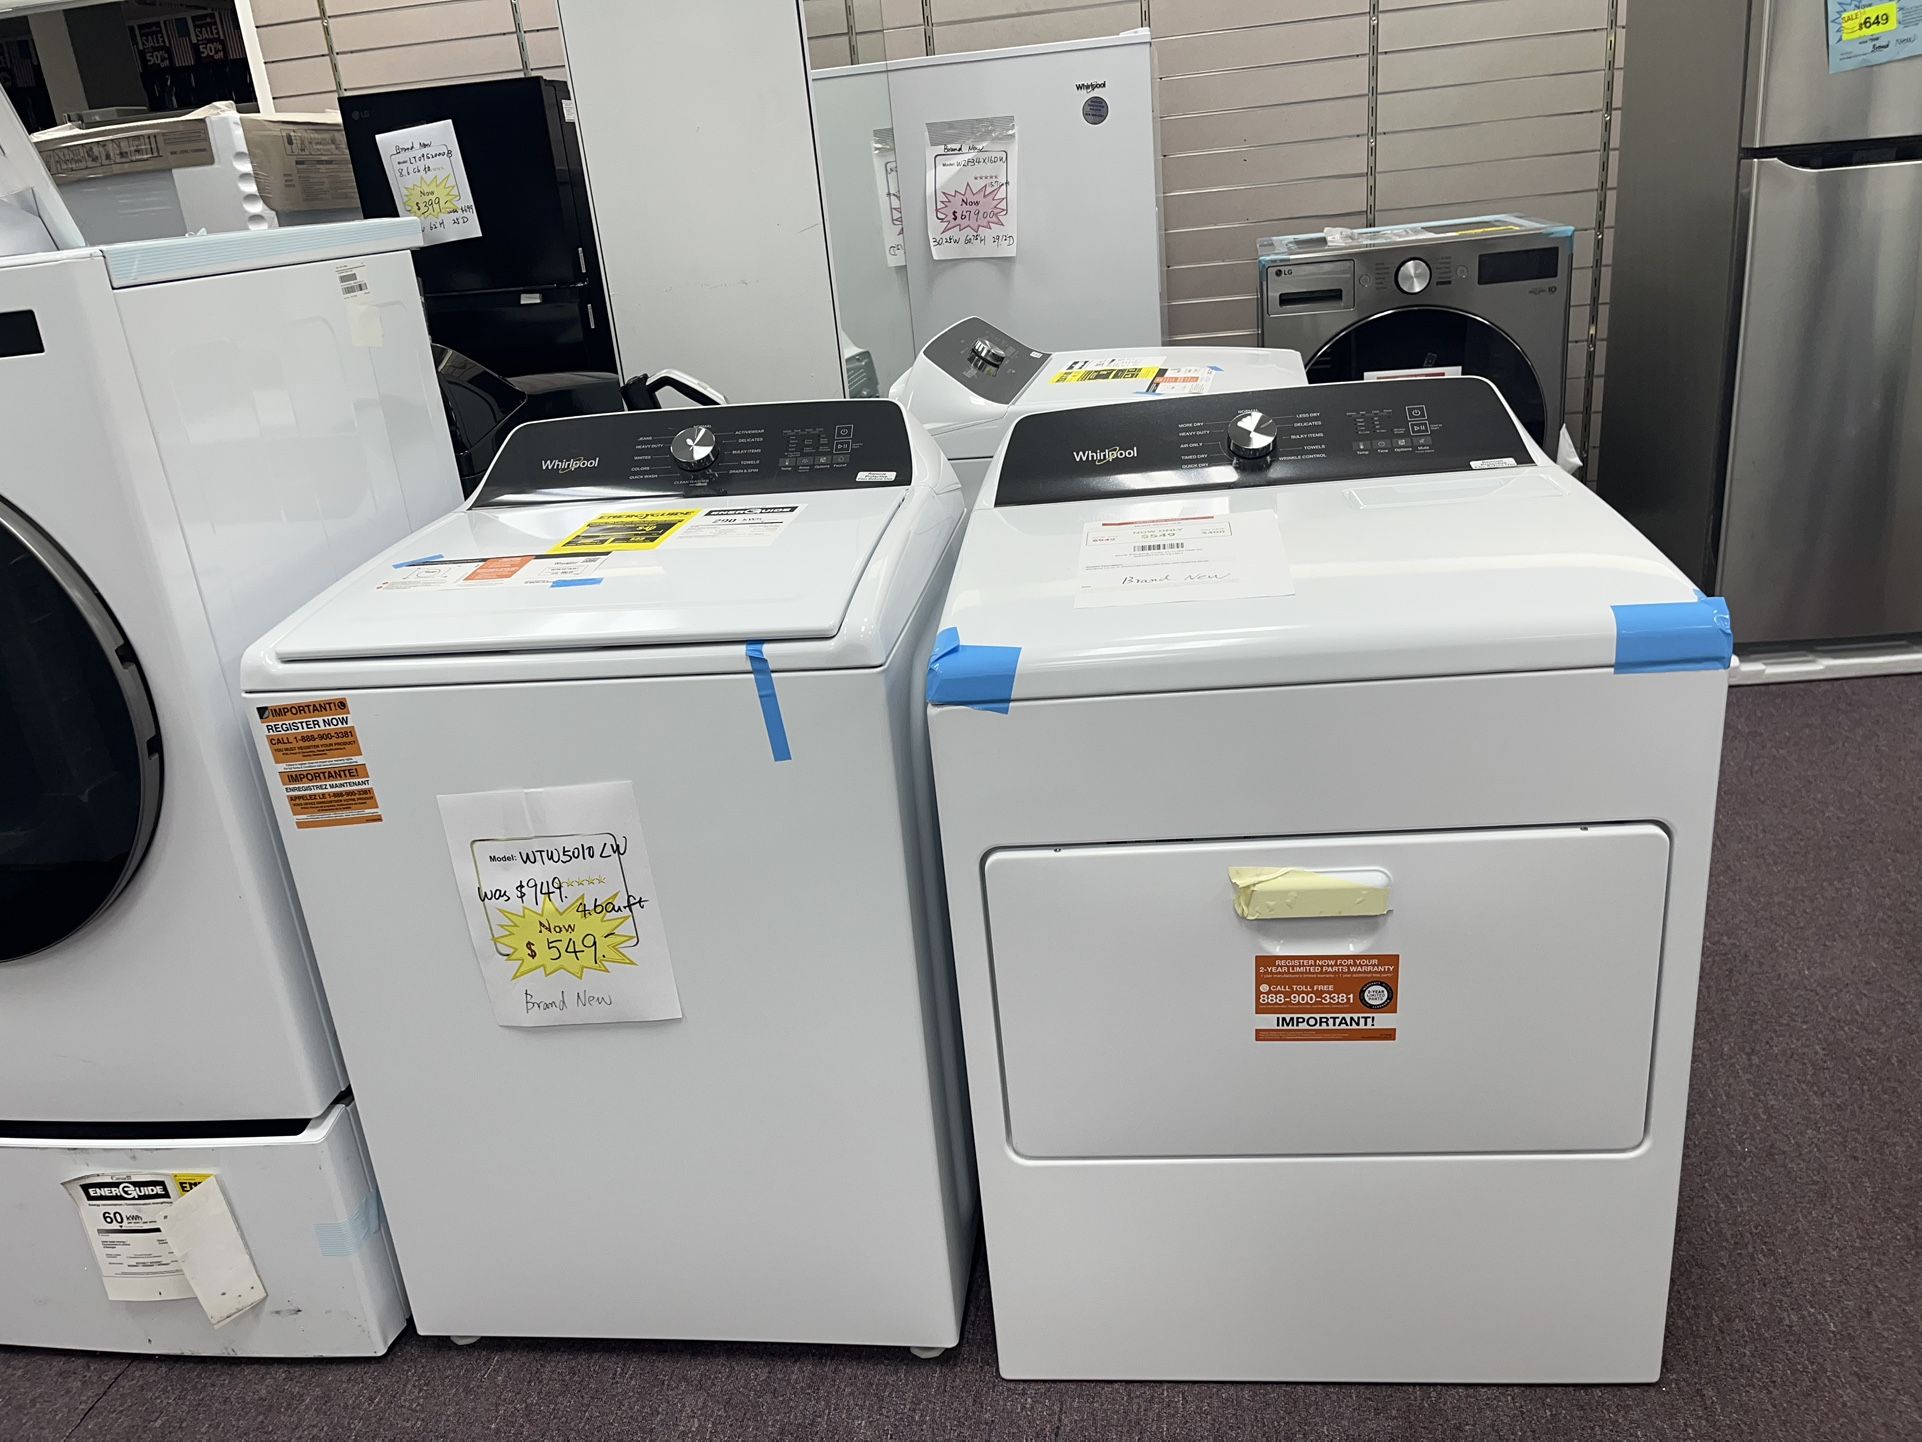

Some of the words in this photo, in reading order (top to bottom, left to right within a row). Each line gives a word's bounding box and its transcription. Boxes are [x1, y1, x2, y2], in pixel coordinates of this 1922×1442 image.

[1858, 13, 1889, 31] $649
[195, 25, 219, 41] SALE
[141, 34, 164, 48] SALE
[199, 41, 222, 57] 50%
[214, 51, 224, 60] off
[146, 50, 168, 65] 50%
[1075, 80, 1106, 92] Whirlpool
[960, 198, 980, 206] Now
[1073, 446, 1138, 464] Whirlpool
[542, 457, 600, 472] Whirlpool
[1122, 574, 1171, 585] Brand
[270, 701, 337, 718] IMPORTANT!
[266, 719, 320, 734] REGISTER
[323, 716, 349, 728] NOW
[270, 736, 292, 746] CALL
[294, 730, 354, 744] 1-888-900-3381
[287, 768, 360, 783] IMPORTANTE!
[285, 784, 328, 793] ENREGISTREZ
[329, 780, 370, 789] MAINTENANT
[328, 790, 372, 798] 1-888-900-3381
[488, 854, 518, 863] Model:
[538, 919, 576, 935] Now
[524, 988, 568, 1014] Brand
[576, 990, 613, 1006] New
[1260, 994, 1354, 1004] 888-900-3381
[1276, 1016, 1375, 1027] IMPORTANT!
[88, 1183, 166, 1198] ENERGUIDE
[102, 1211, 124, 1224] 60
